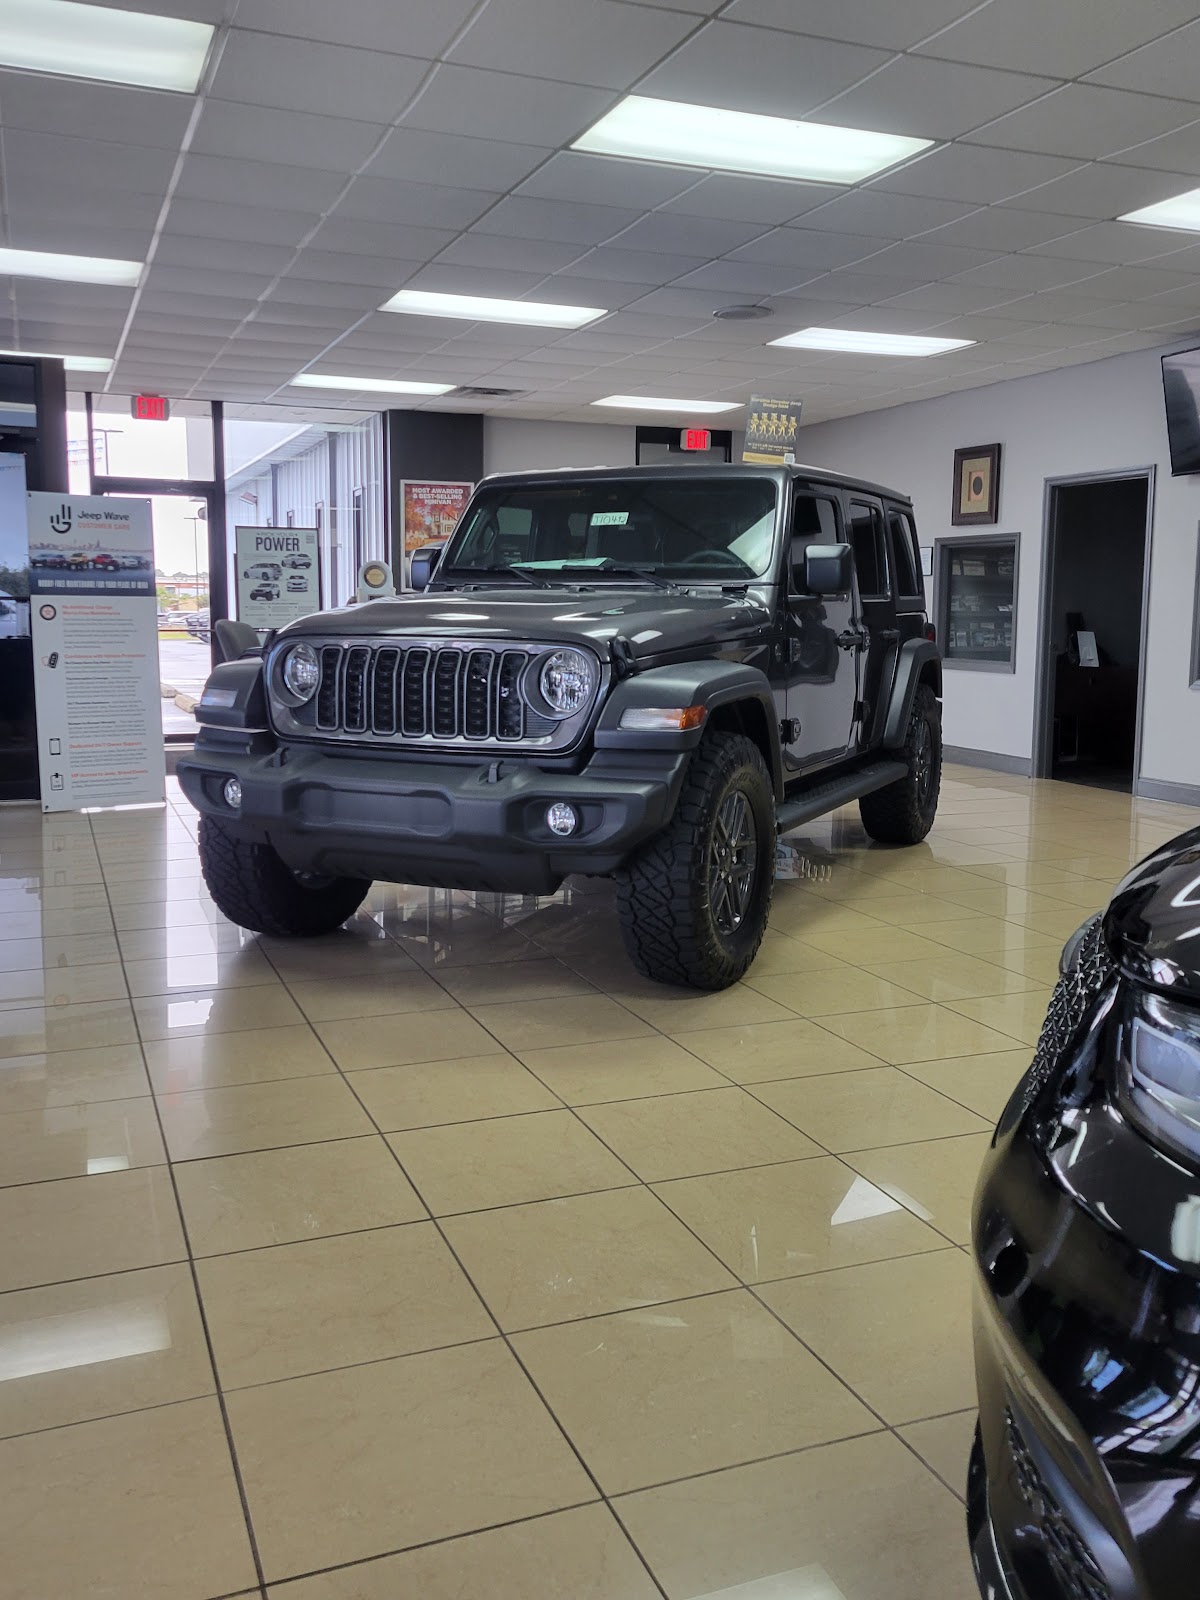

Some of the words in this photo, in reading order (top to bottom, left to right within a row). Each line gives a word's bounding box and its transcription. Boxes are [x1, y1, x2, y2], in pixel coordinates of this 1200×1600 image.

[137, 397, 165, 419] EXIT
[687, 430, 708, 449] EXIT
[77, 510, 102, 520] Jeep
[103, 511, 130, 521] Wave
[255, 536, 300, 552] POWER
